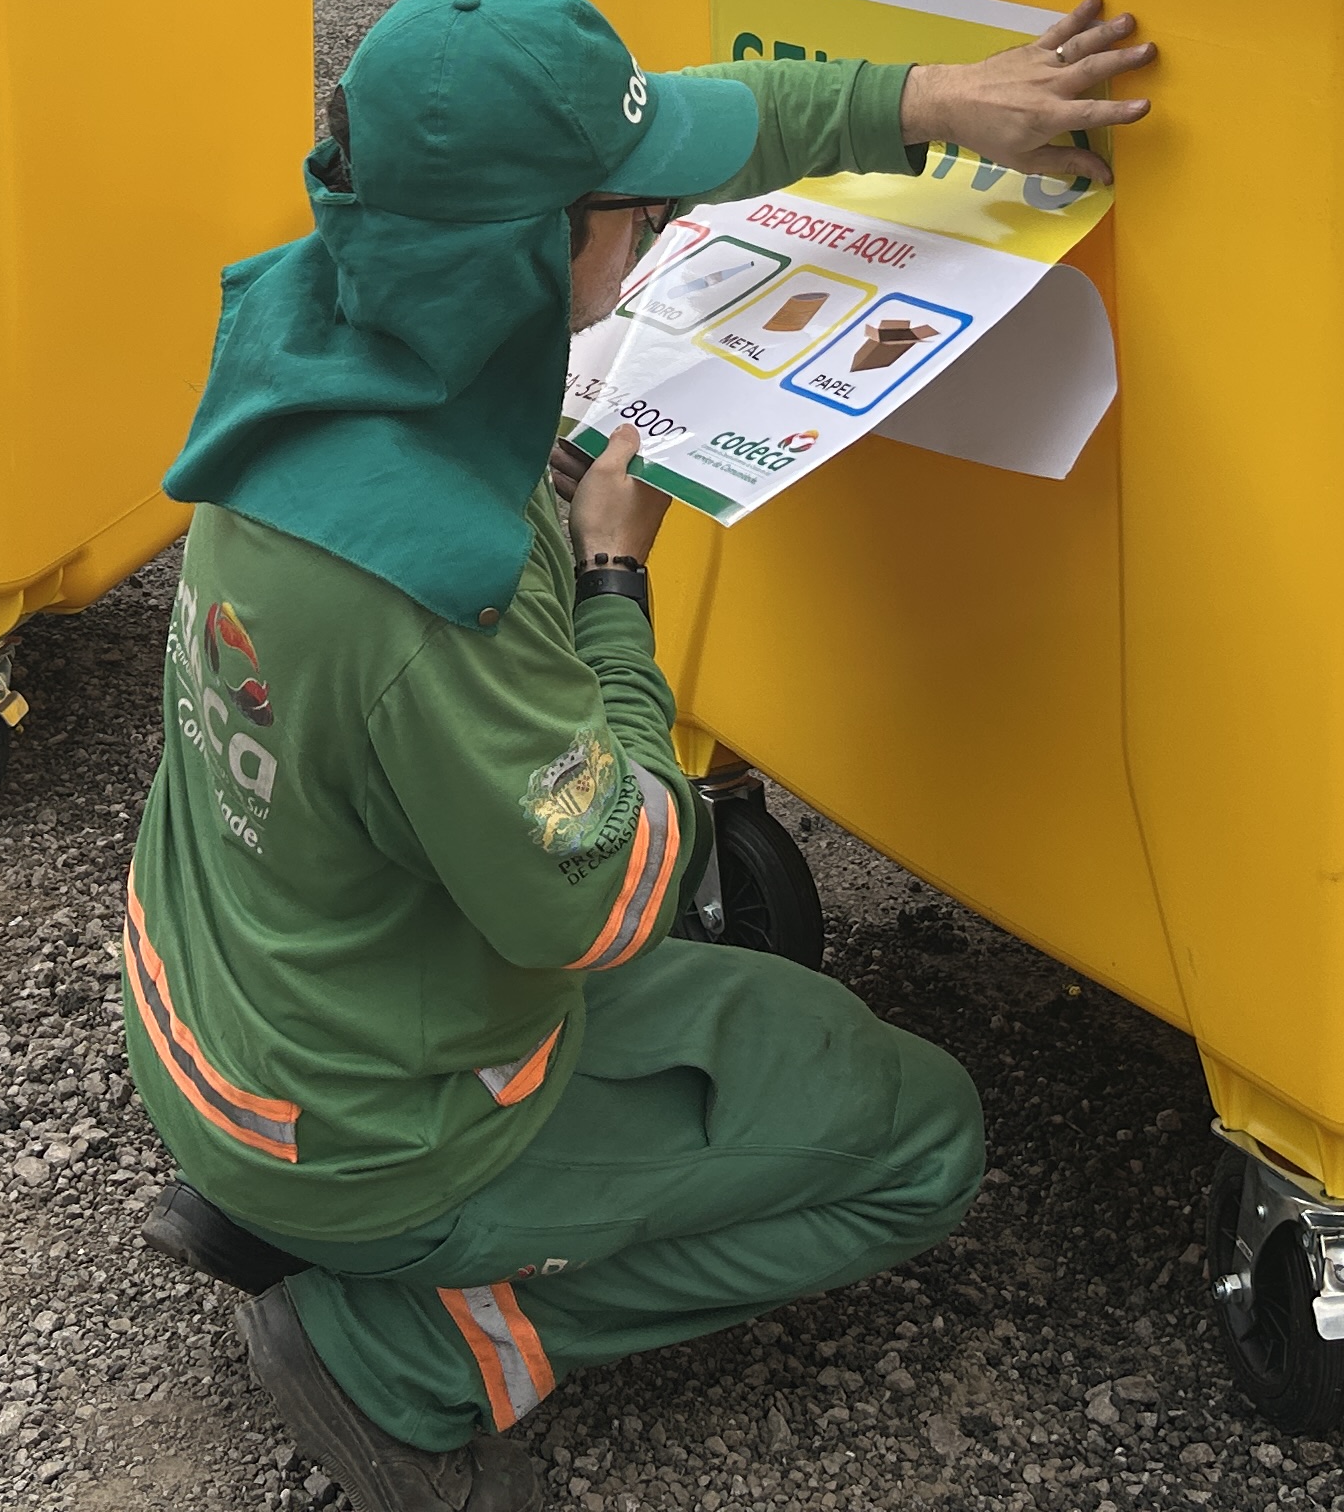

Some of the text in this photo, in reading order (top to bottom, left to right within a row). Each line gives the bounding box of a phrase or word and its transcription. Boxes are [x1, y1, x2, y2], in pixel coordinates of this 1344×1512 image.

[746, 204, 917, 269] DEPOSITE AQUI:
[642, 299, 684, 321] VIDRO
[719, 333, 767, 362] METAL
[809, 374, 857, 400] PAPEL
[710, 431, 796, 472] codeca
[247, 797, 269, 820] Sul
[558, 774, 638, 875] PREFEITURA
[567, 868, 588, 885] DE
[588, 828, 633, 870] CAXIAS
